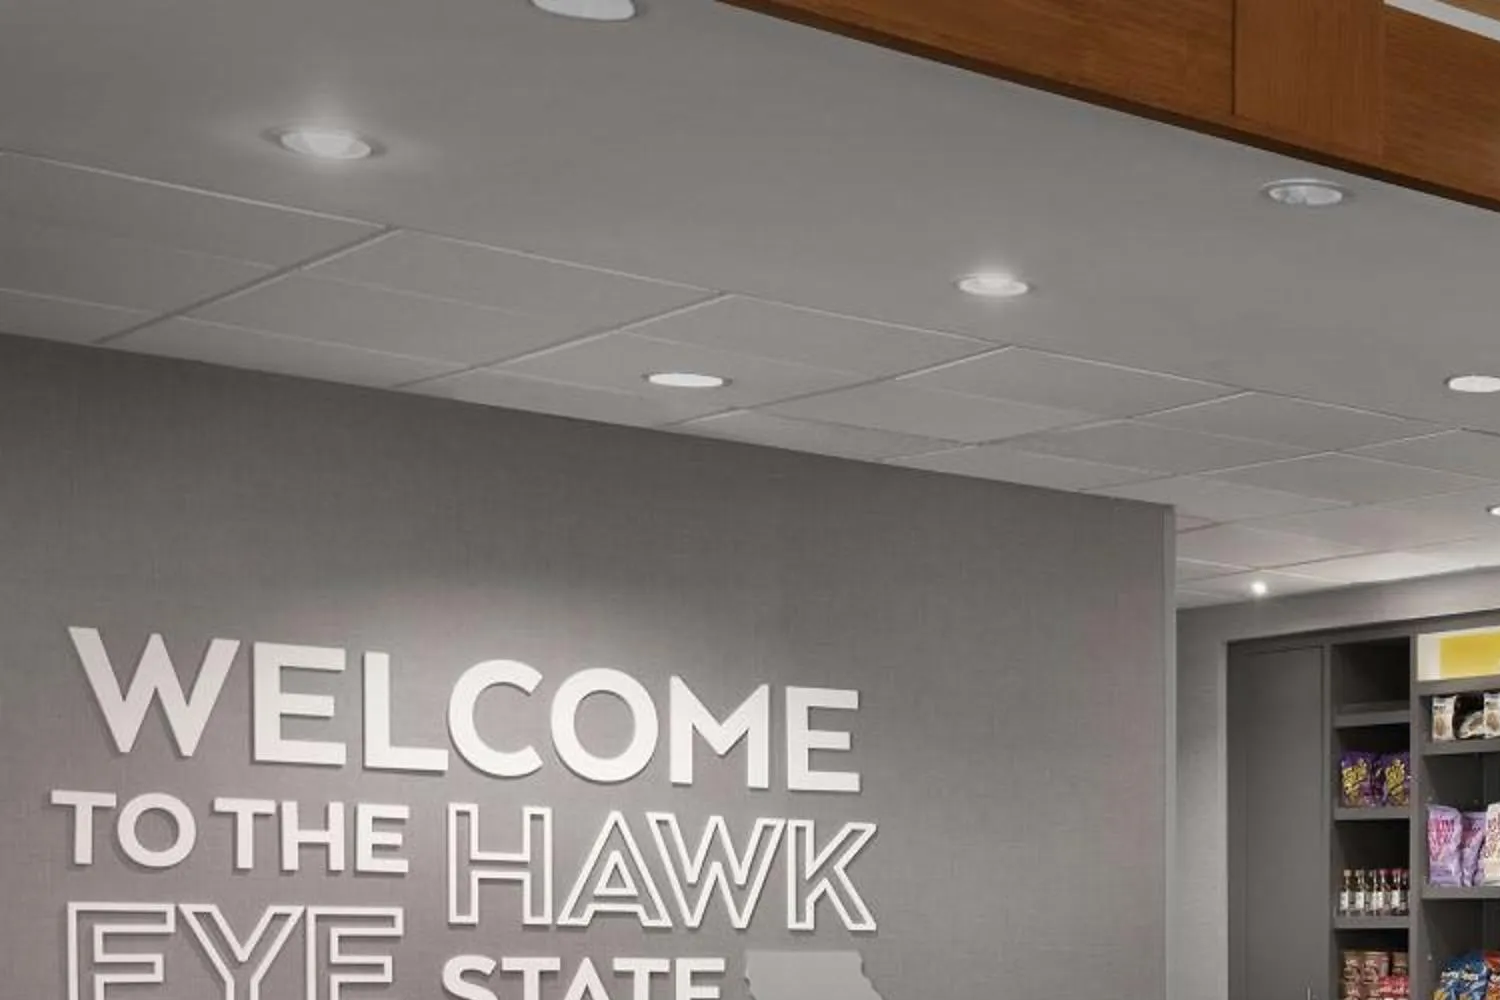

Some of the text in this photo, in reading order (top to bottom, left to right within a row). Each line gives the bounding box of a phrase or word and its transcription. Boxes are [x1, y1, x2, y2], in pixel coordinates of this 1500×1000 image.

[68, 626, 861, 793] WELCOME
[52, 789, 878, 931] TO THE HAWK
